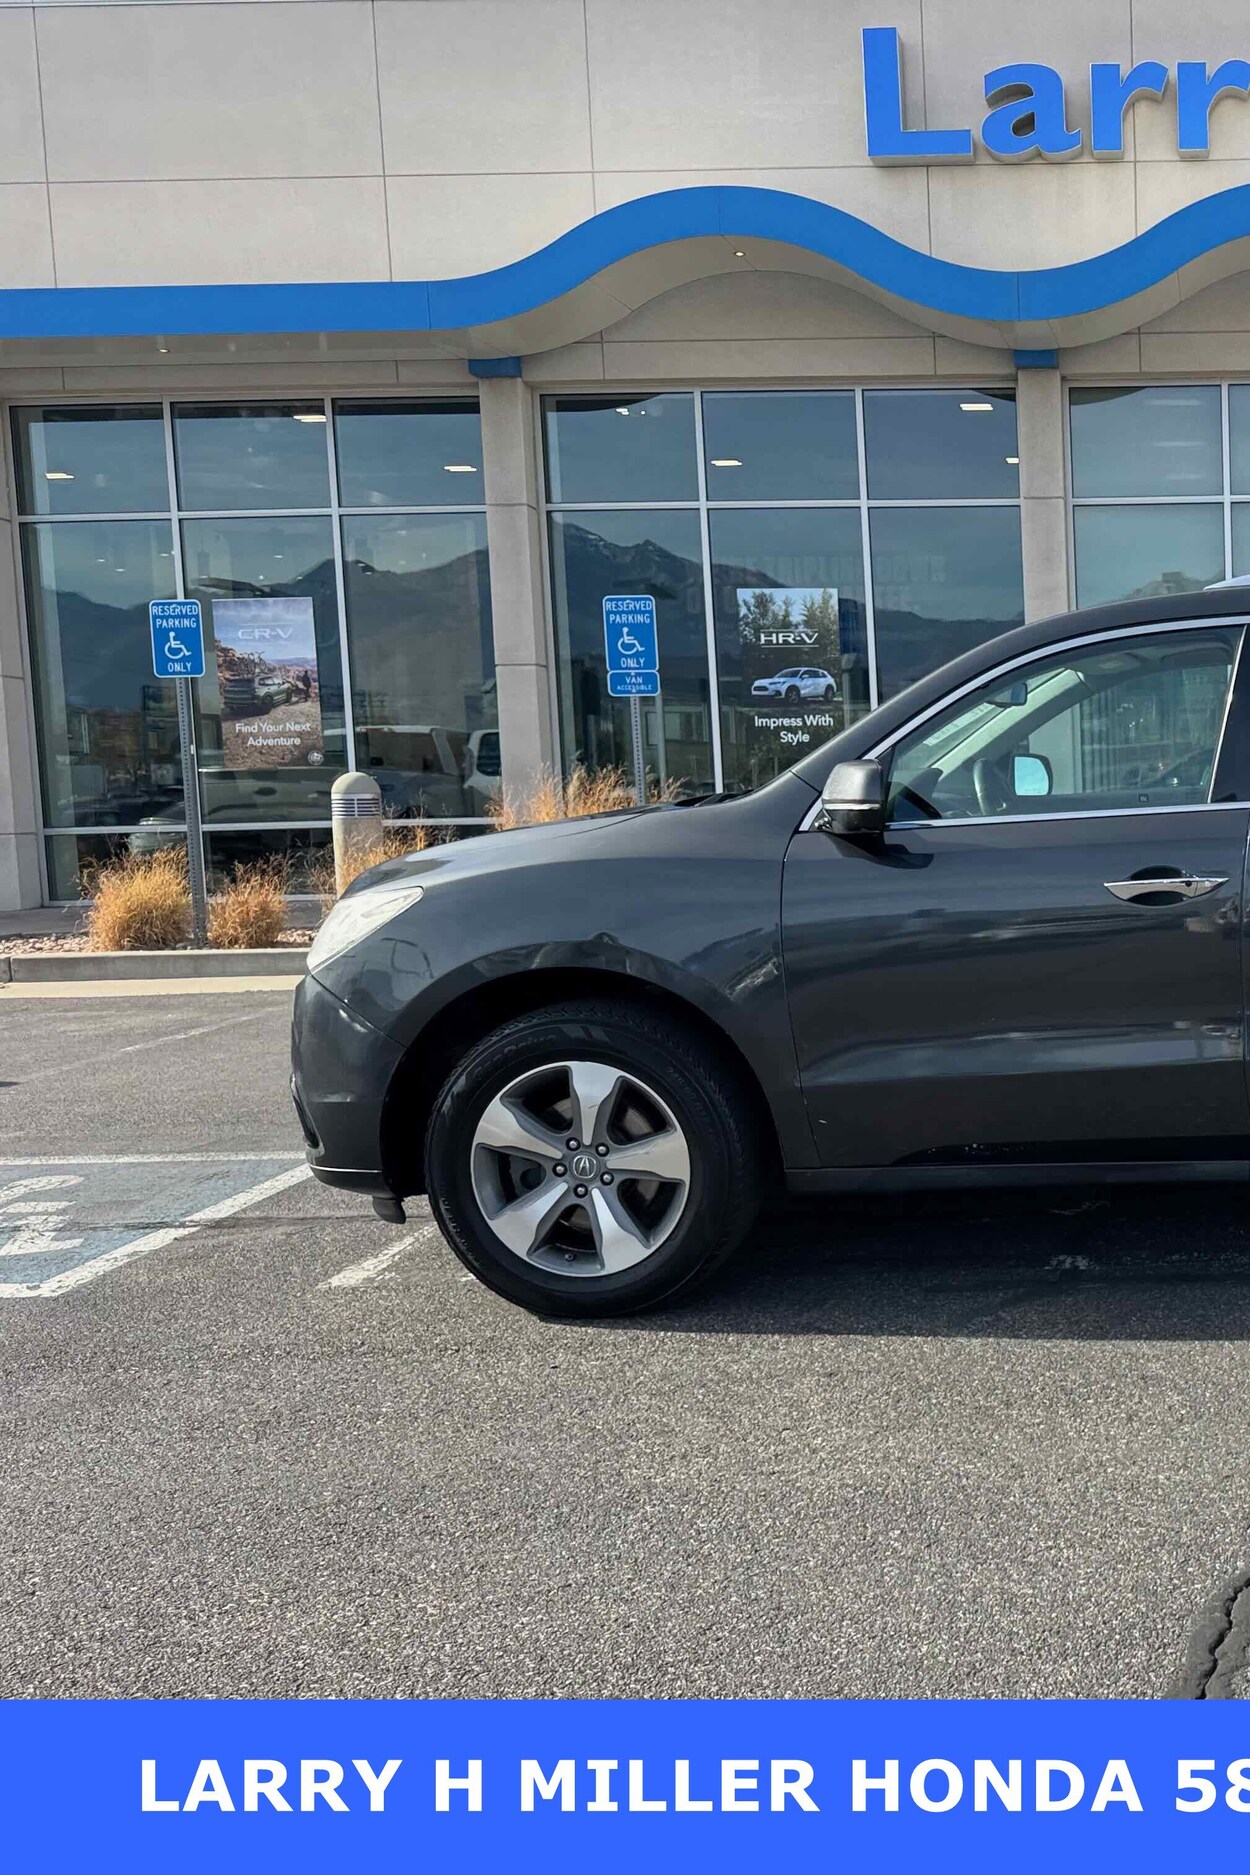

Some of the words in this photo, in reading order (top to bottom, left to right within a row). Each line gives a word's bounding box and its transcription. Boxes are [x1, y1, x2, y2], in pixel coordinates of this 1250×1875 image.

[152, 604, 199, 616] RESERVED
[605, 600, 652, 611] RESERVED
[156, 617, 197, 629] PARKING
[609, 613, 650, 624] PARKING
[237, 627, 293, 640] CR-V
[760, 632, 819, 644] HR-V
[167, 662, 192, 673] ONLY
[620, 657, 646, 668] ONLY
[625, 675, 643, 684] VAN
[754, 715, 803, 729] Impress
[804, 714, 834, 727] With
[235, 723, 258, 733] Find
[259, 722, 284, 733] Your
[285, 722, 312, 732] Next
[247, 736, 301, 746] Adventure
[780, 730, 811, 745] Style
